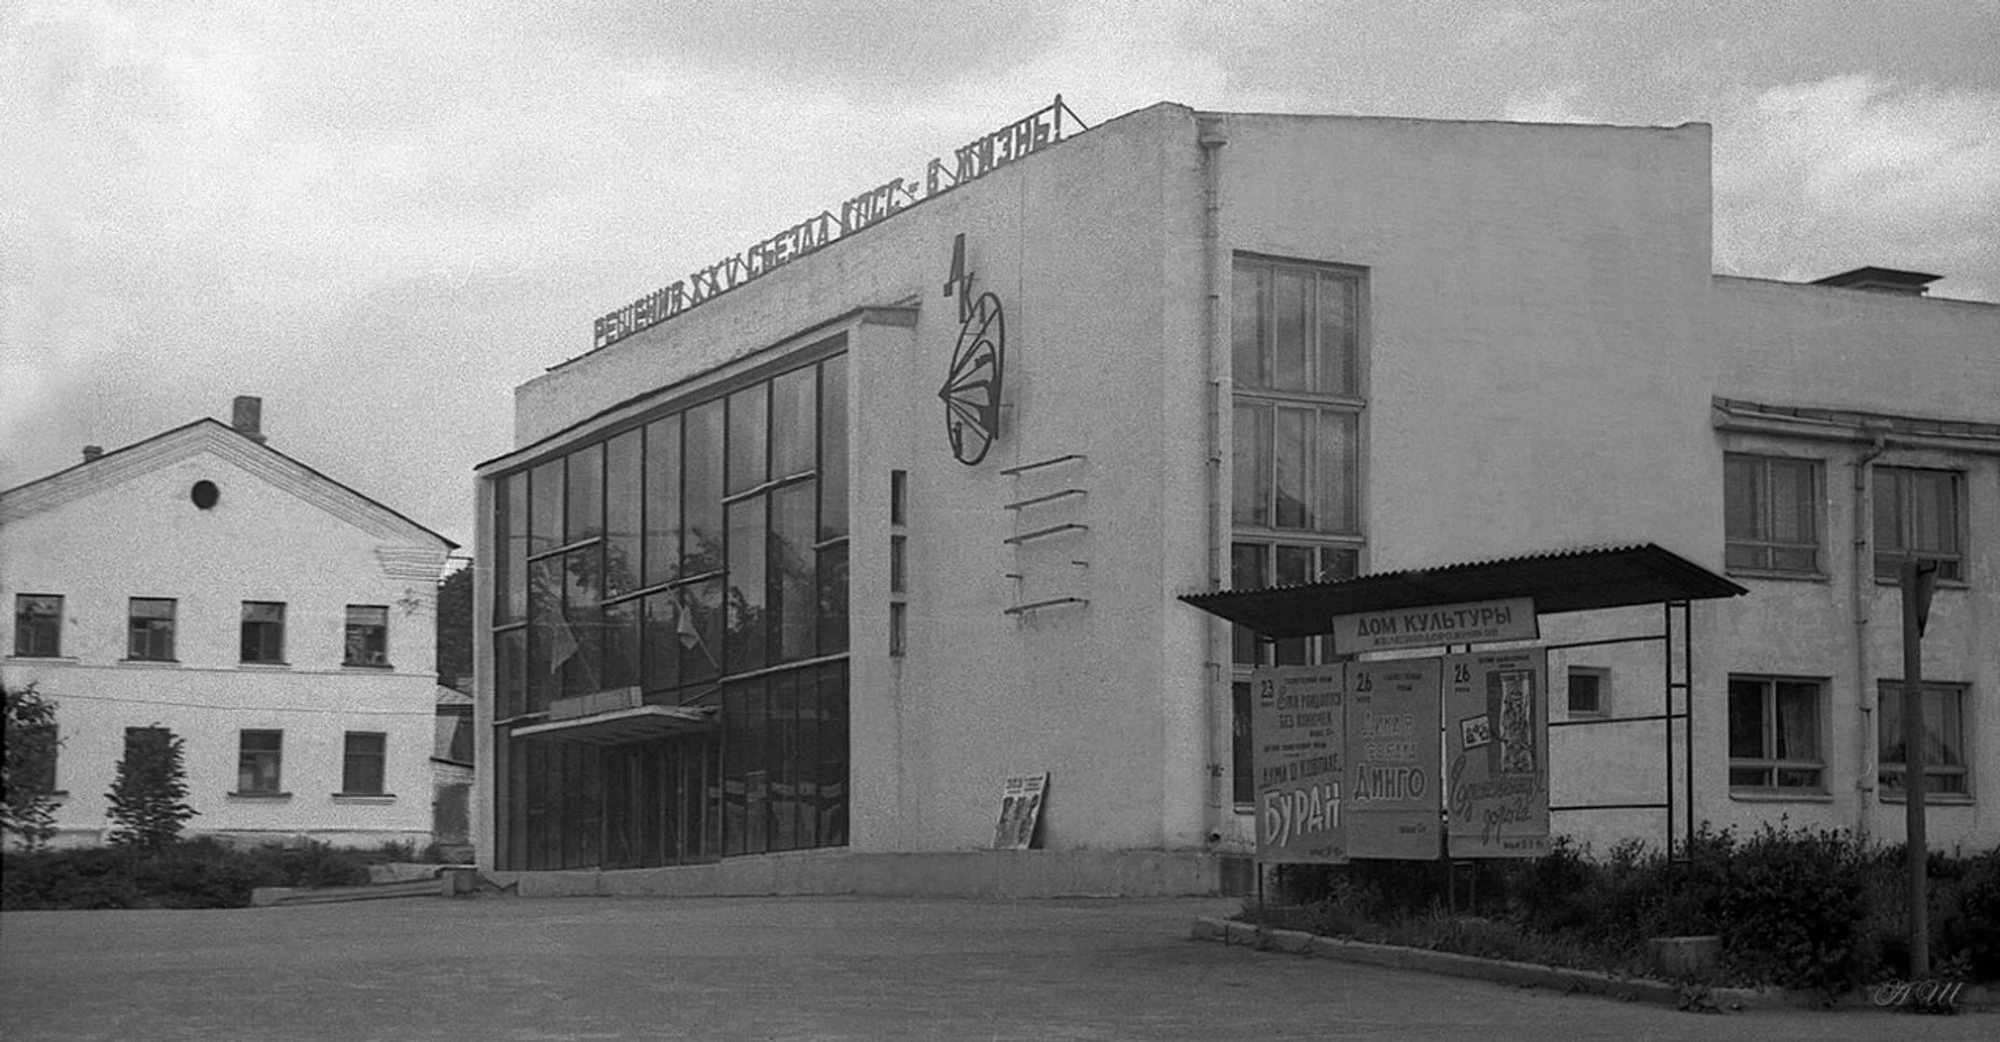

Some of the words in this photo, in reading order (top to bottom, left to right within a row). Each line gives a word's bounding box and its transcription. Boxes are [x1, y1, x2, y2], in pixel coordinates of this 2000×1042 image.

[594, 280, 684, 349] РЕШЕНИЯ
[747, 211, 828, 282] СЪЕЗДА
[841, 177, 903, 233] КПСС
[926, 157, 940, 198] В
[954, 93, 1062, 186] ЖИЗНЬ!
[1357, 616, 1397, 637] ДОМ
[1403, 606, 1511, 633] КУЛЬТУРЫ
[1261, 679, 1274, 698] 23
[1356, 672, 1372, 692] 26
[1455, 663, 1470, 683] 26
[1353, 763, 1426, 802] ДИНГО
[1263, 780, 1341, 848] БУРАН
